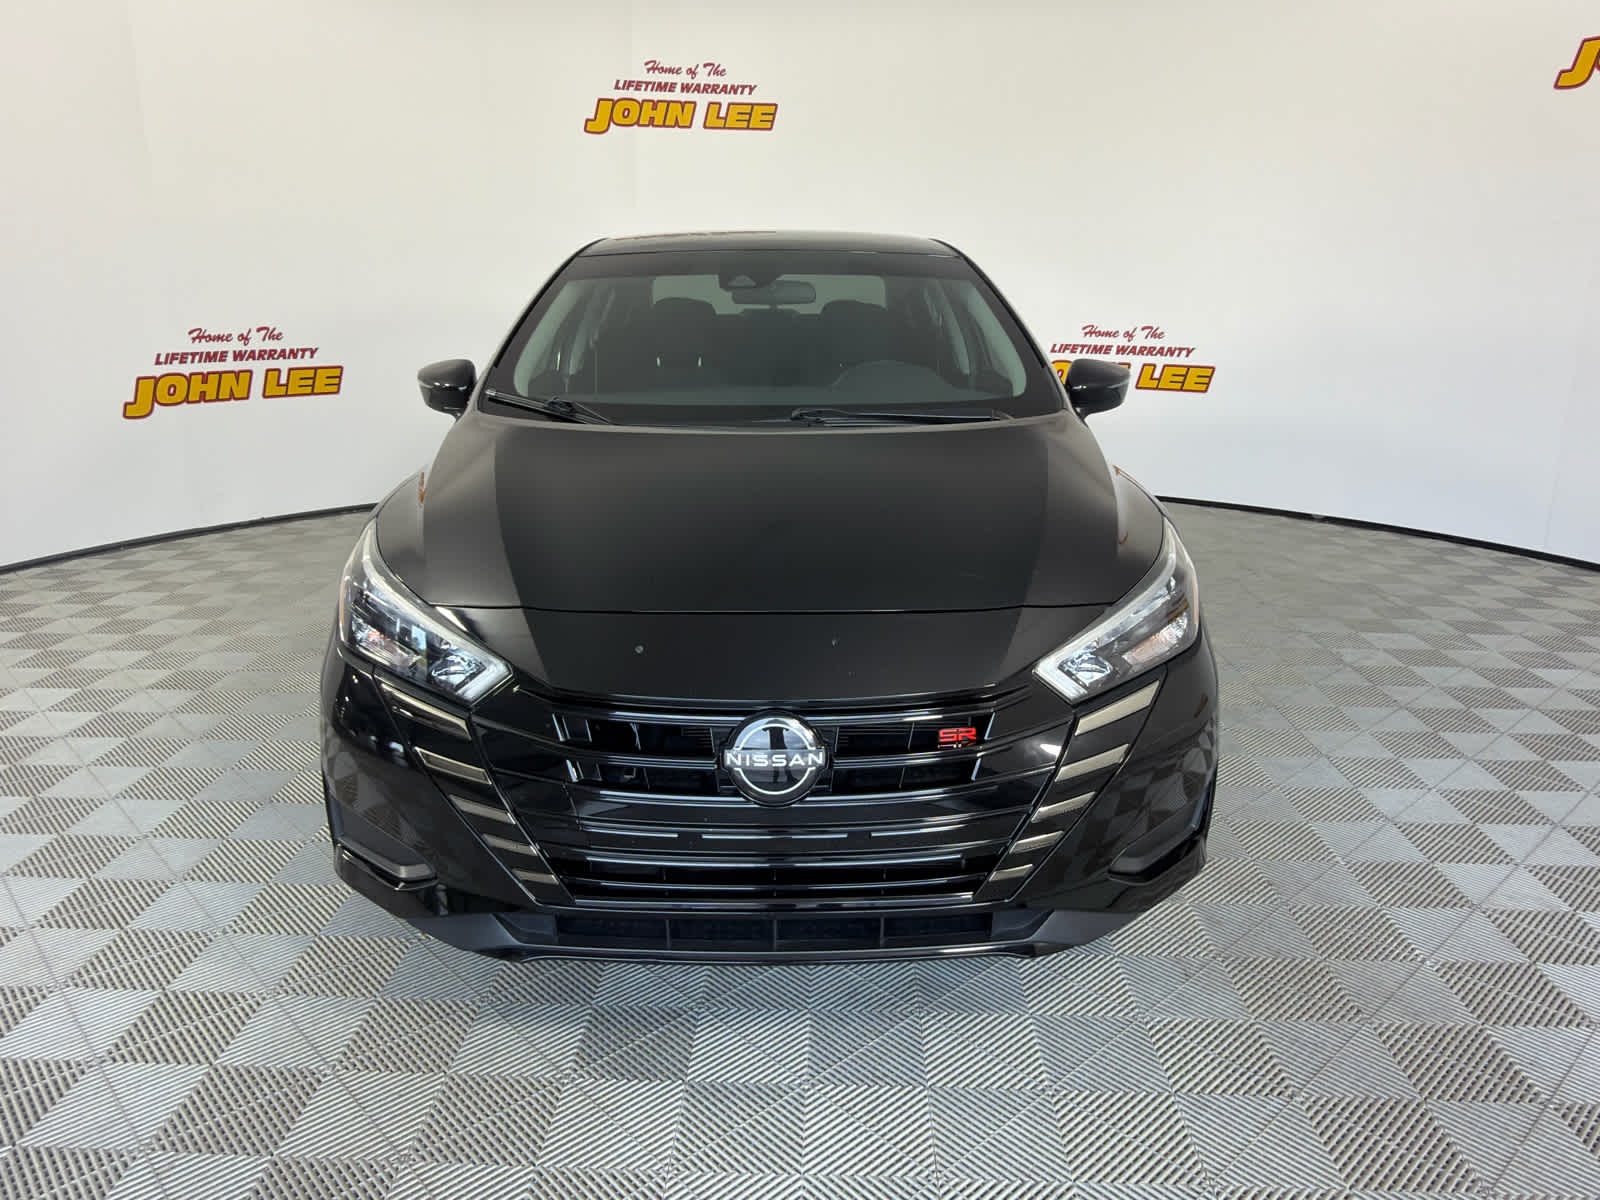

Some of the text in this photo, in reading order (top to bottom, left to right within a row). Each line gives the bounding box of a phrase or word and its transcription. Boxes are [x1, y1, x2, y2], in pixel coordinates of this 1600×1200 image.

[644, 60, 727, 79] Home of The
[614, 79, 757, 95] LIFETIME WARRANTY
[584, 97, 778, 134] JOHN LEE
[188, 326, 284, 346] Home of The
[1081, 324, 1165, 343] Home of The
[154, 347, 319, 366] LIFETIME WARRANTY
[1050, 343, 1195, 358] LIFETIME WARRANTY
[1135, 363, 1216, 393] LEE
[123, 365, 344, 420] JOHN LEE
[938, 727, 977, 743] SR
[724, 750, 825, 768] NISSAN
